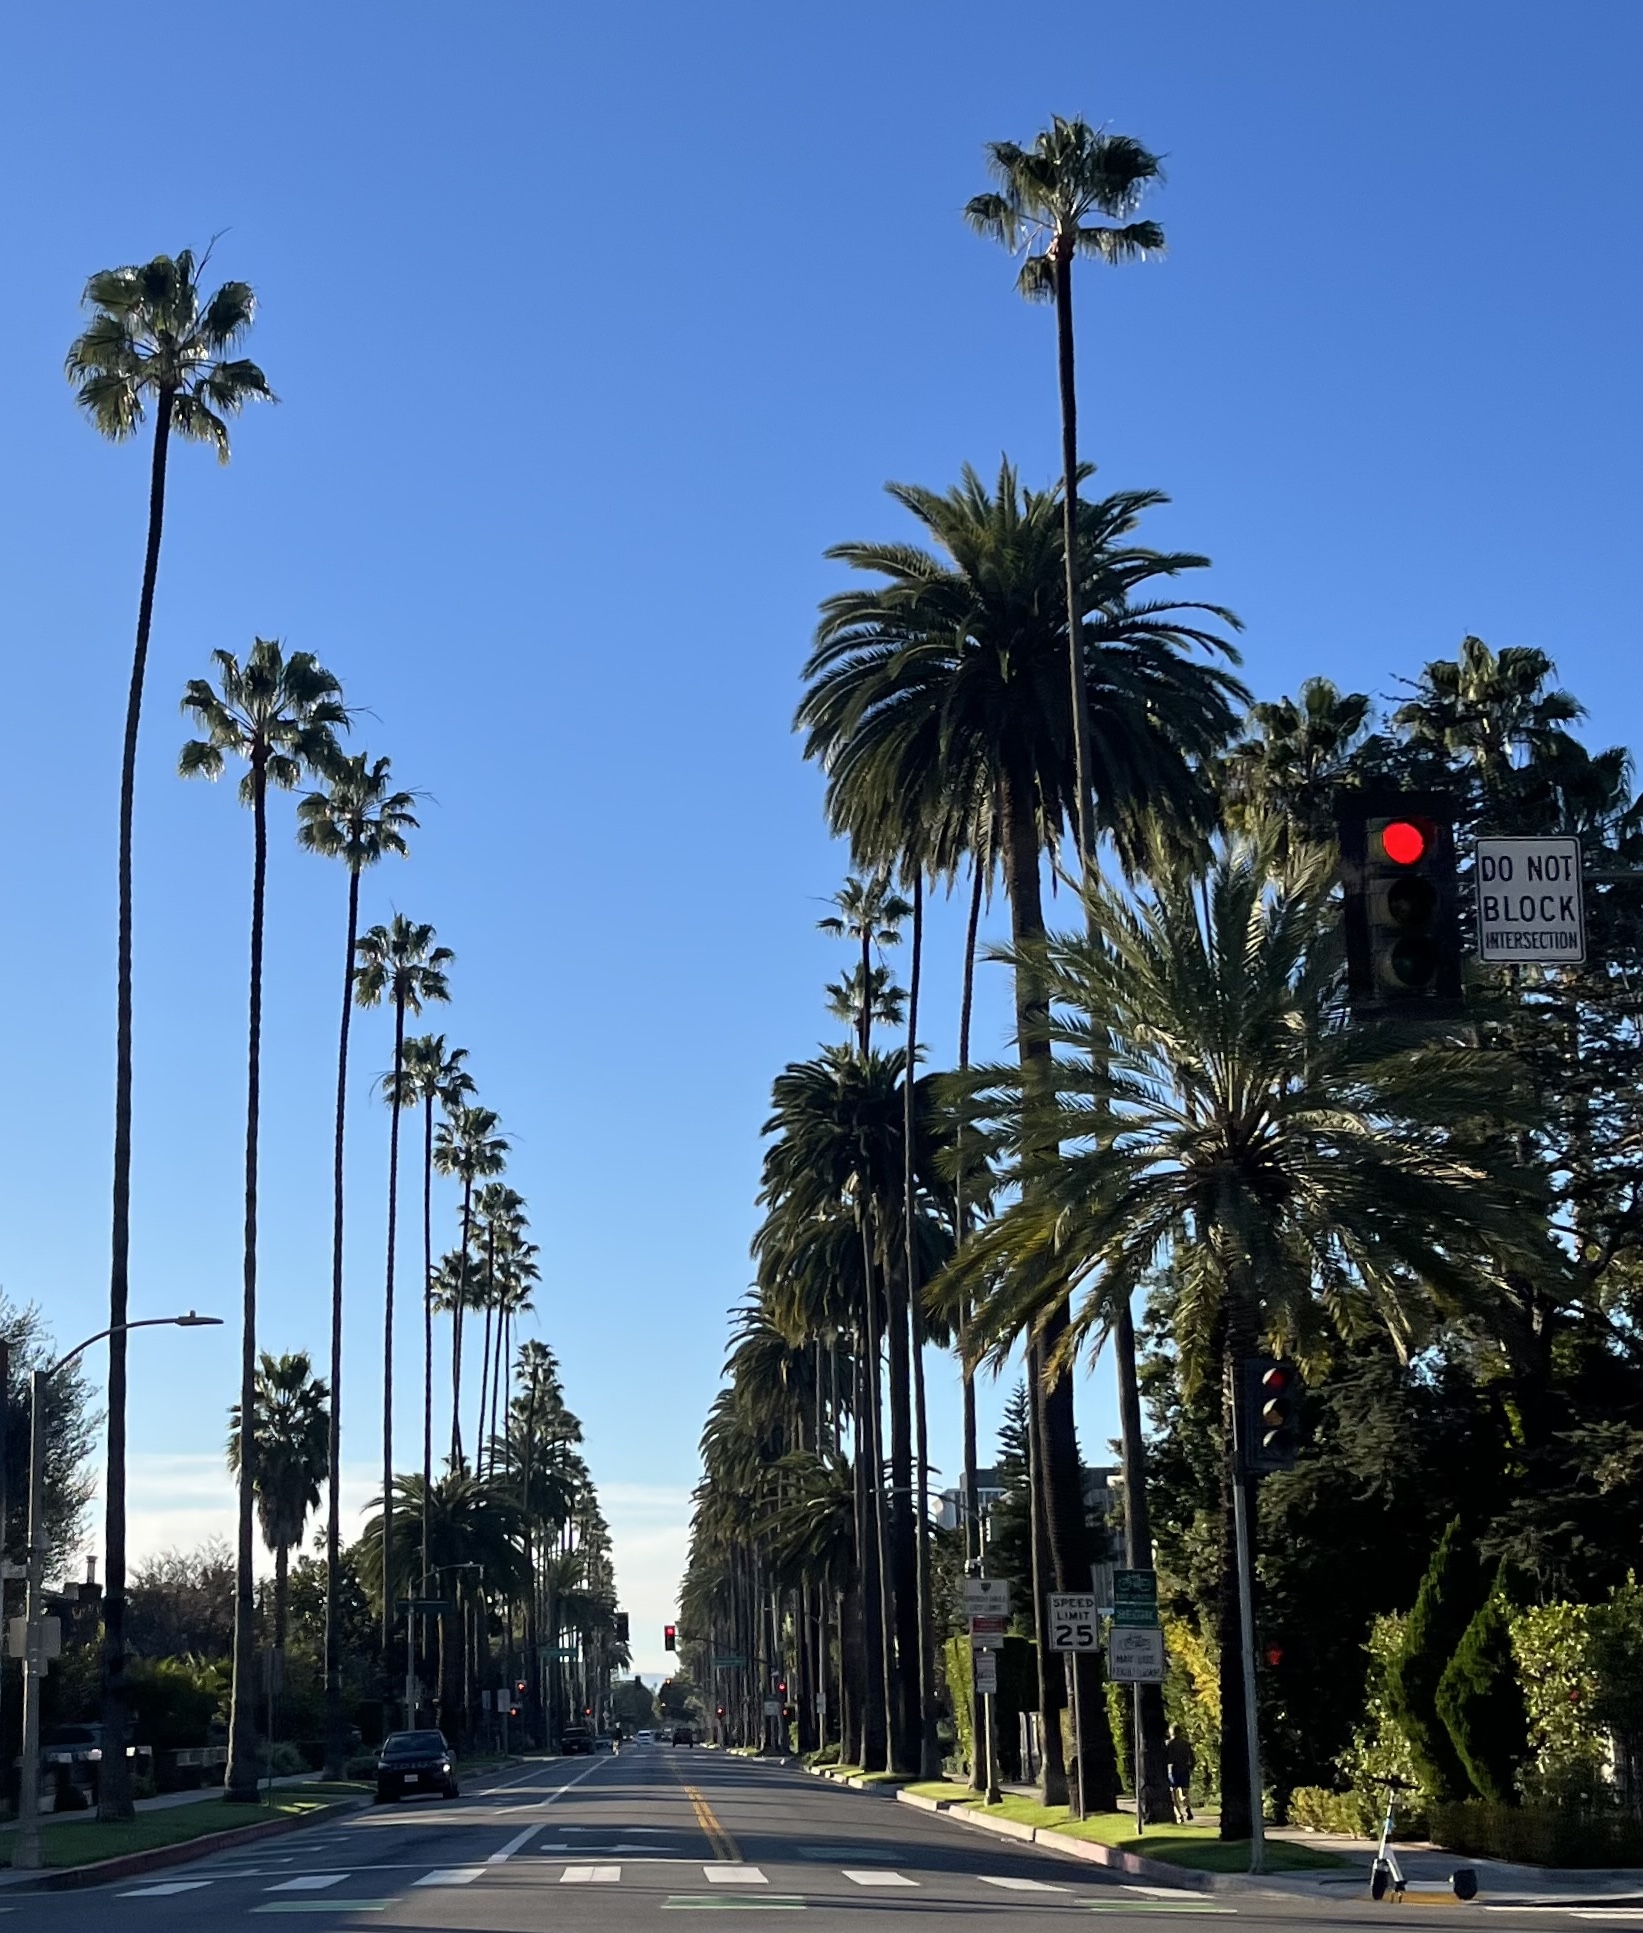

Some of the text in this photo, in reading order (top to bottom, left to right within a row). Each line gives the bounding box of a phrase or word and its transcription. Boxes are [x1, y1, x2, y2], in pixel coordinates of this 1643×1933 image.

[1481, 855, 1573, 882] DO NOT
[1483, 895, 1576, 922] BLOCK
[1485, 931, 1578, 949] INTERSECTION
[1052, 1598, 1094, 1608] SPEED
[1057, 1611, 1090, 1621] LIMIT
[1056, 1625, 1093, 1646] 25
